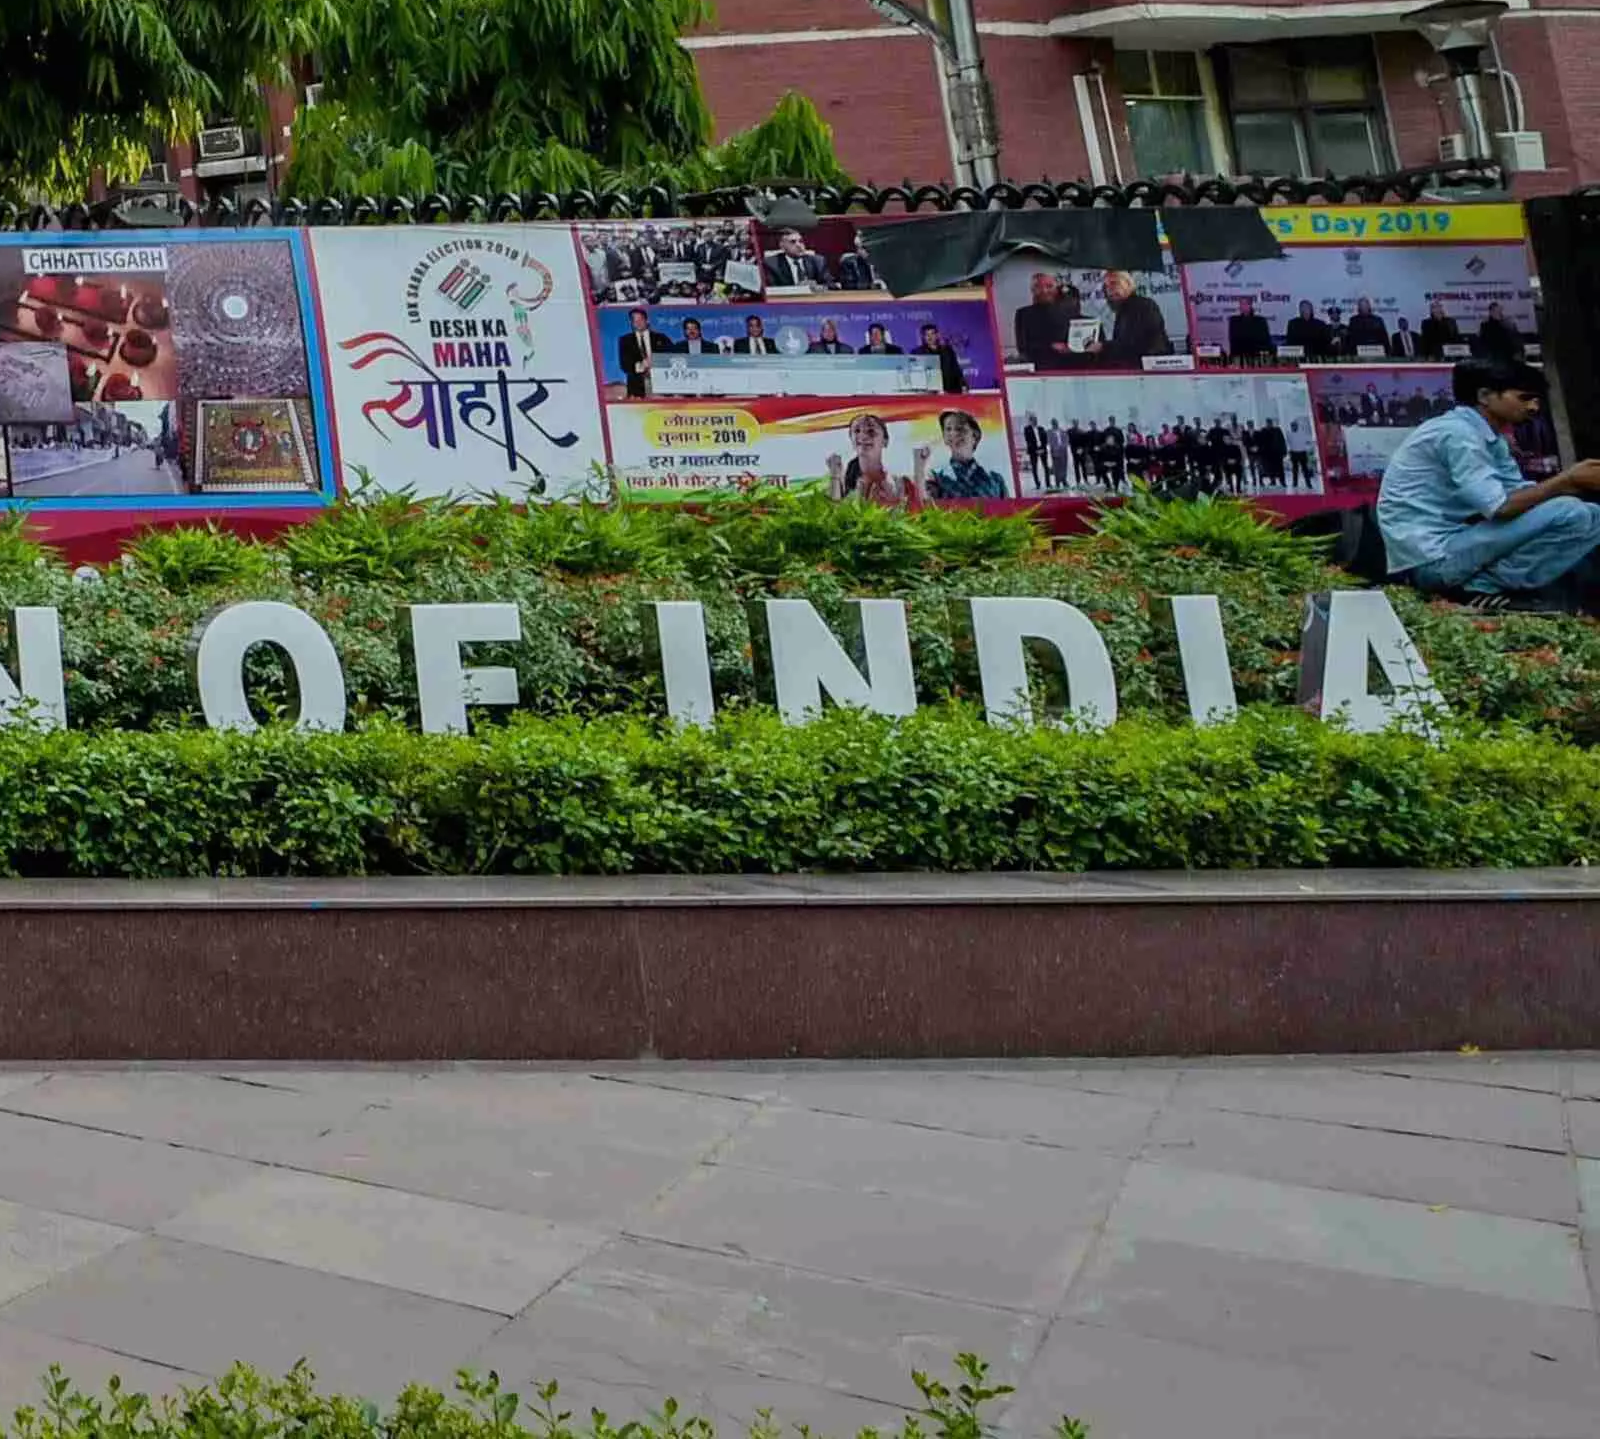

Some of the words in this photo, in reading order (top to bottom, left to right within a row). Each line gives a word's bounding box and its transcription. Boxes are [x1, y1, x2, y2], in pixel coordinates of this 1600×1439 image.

[1312, 213, 1366, 236] Day
[1379, 212, 1450, 232] 2019
[29, 252, 164, 272] CHHATTISGARH
[426, 239, 483, 264] ELECTION
[429, 319, 478, 338] DESH
[482, 319, 508, 337] KA
[433, 341, 512, 368] MAHA
[714, 430, 746, 443] 2019
[198, 600, 522, 736] OF
[655, 590, 1452, 751] INDIA
